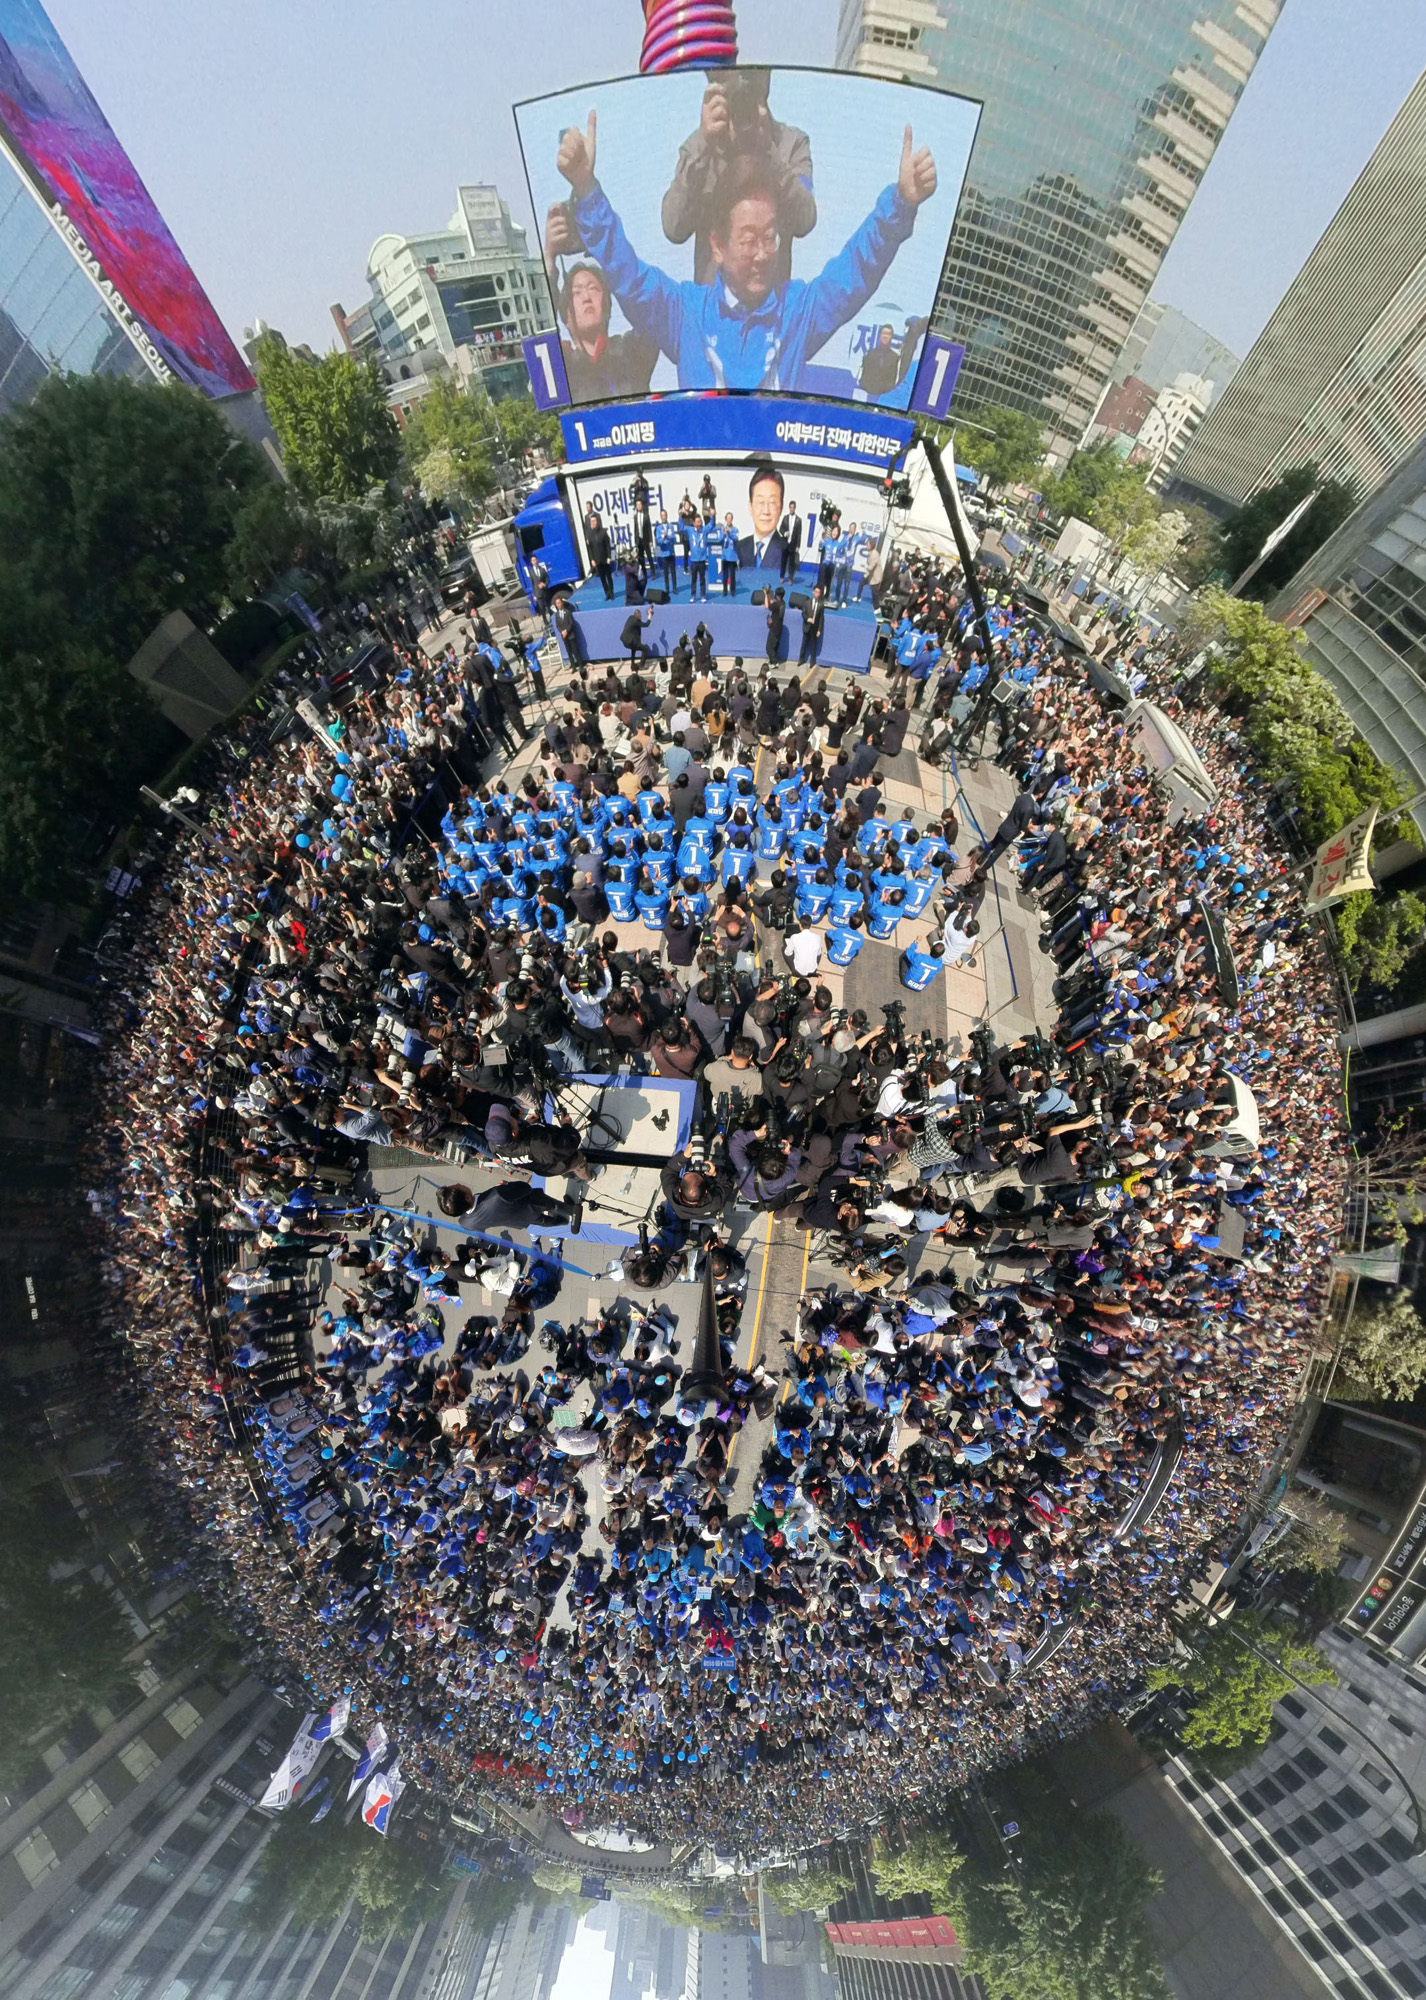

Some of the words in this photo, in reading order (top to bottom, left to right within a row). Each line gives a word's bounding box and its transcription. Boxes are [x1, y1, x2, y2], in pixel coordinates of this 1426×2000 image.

[50, 202, 102, 277] MEDIA
[101, 280, 133, 319] ART
[131, 321, 176, 386] SEOUL
[534, 343, 558, 398] 1
[928, 348, 950, 407] 1
[575, 422, 588, 451] 1
[592, 437, 612, 448] 지금은
[611, 421, 655, 446] 이재명
[776, 420, 825, 446] 이제부터
[826, 427, 852, 450] 진짜
[852, 432, 902, 457] 대한민국
[807, 513, 817, 548] 1
[712, 793, 720, 808] 1
[697, 834, 704, 847] 1
[770, 831, 777, 848] 1
[690, 846, 697, 865] 1
[733, 858, 741, 875] 1
[613, 896, 622, 911] 1
[915, 888, 925, 905] 1
[842, 904, 852, 917] 1
[884, 920, 893, 932] 1
[842, 939, 853, 956] 1
[919, 969, 930, 983] 1
[1384, 1595, 1415, 1632] 동아미디어
